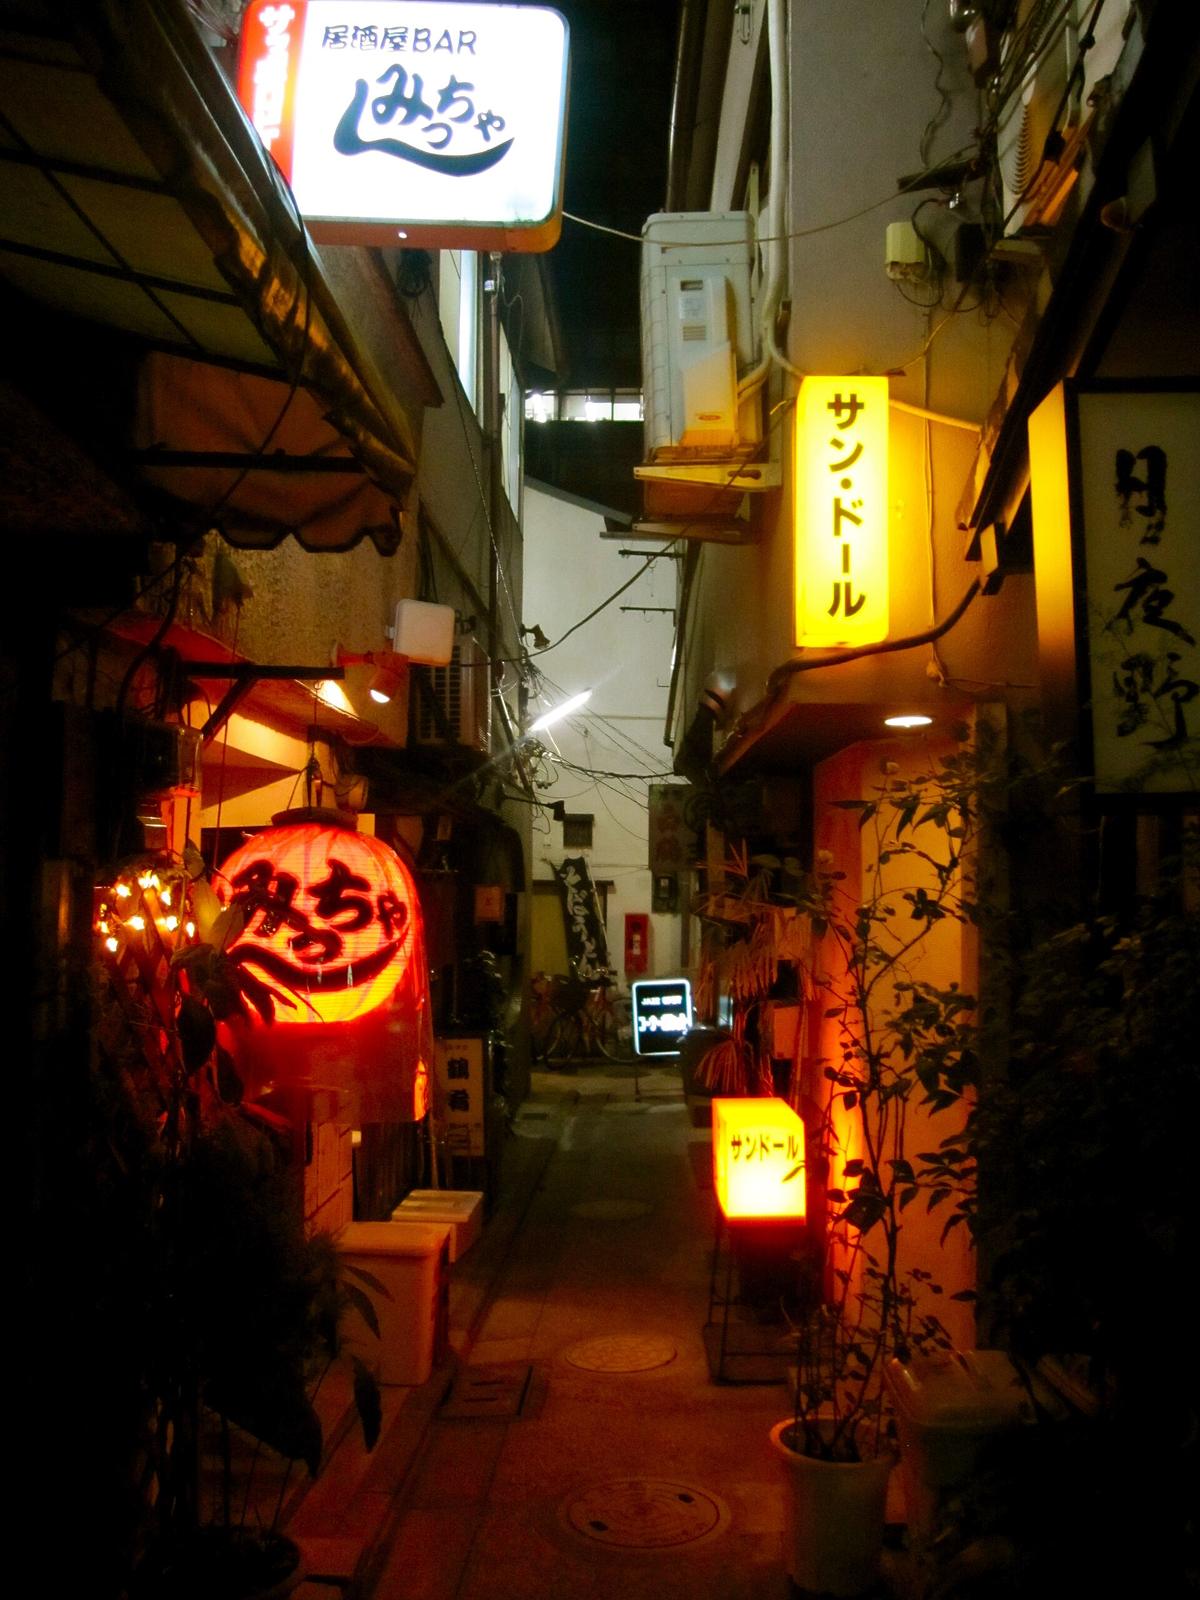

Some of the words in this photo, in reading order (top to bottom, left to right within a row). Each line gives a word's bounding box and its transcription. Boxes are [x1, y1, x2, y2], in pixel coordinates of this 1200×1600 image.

[321, 25, 477, 54] 居酒屋BAR
[826, 393, 866, 618] サン・ドール
[730, 1133, 799, 1161] サンドール
